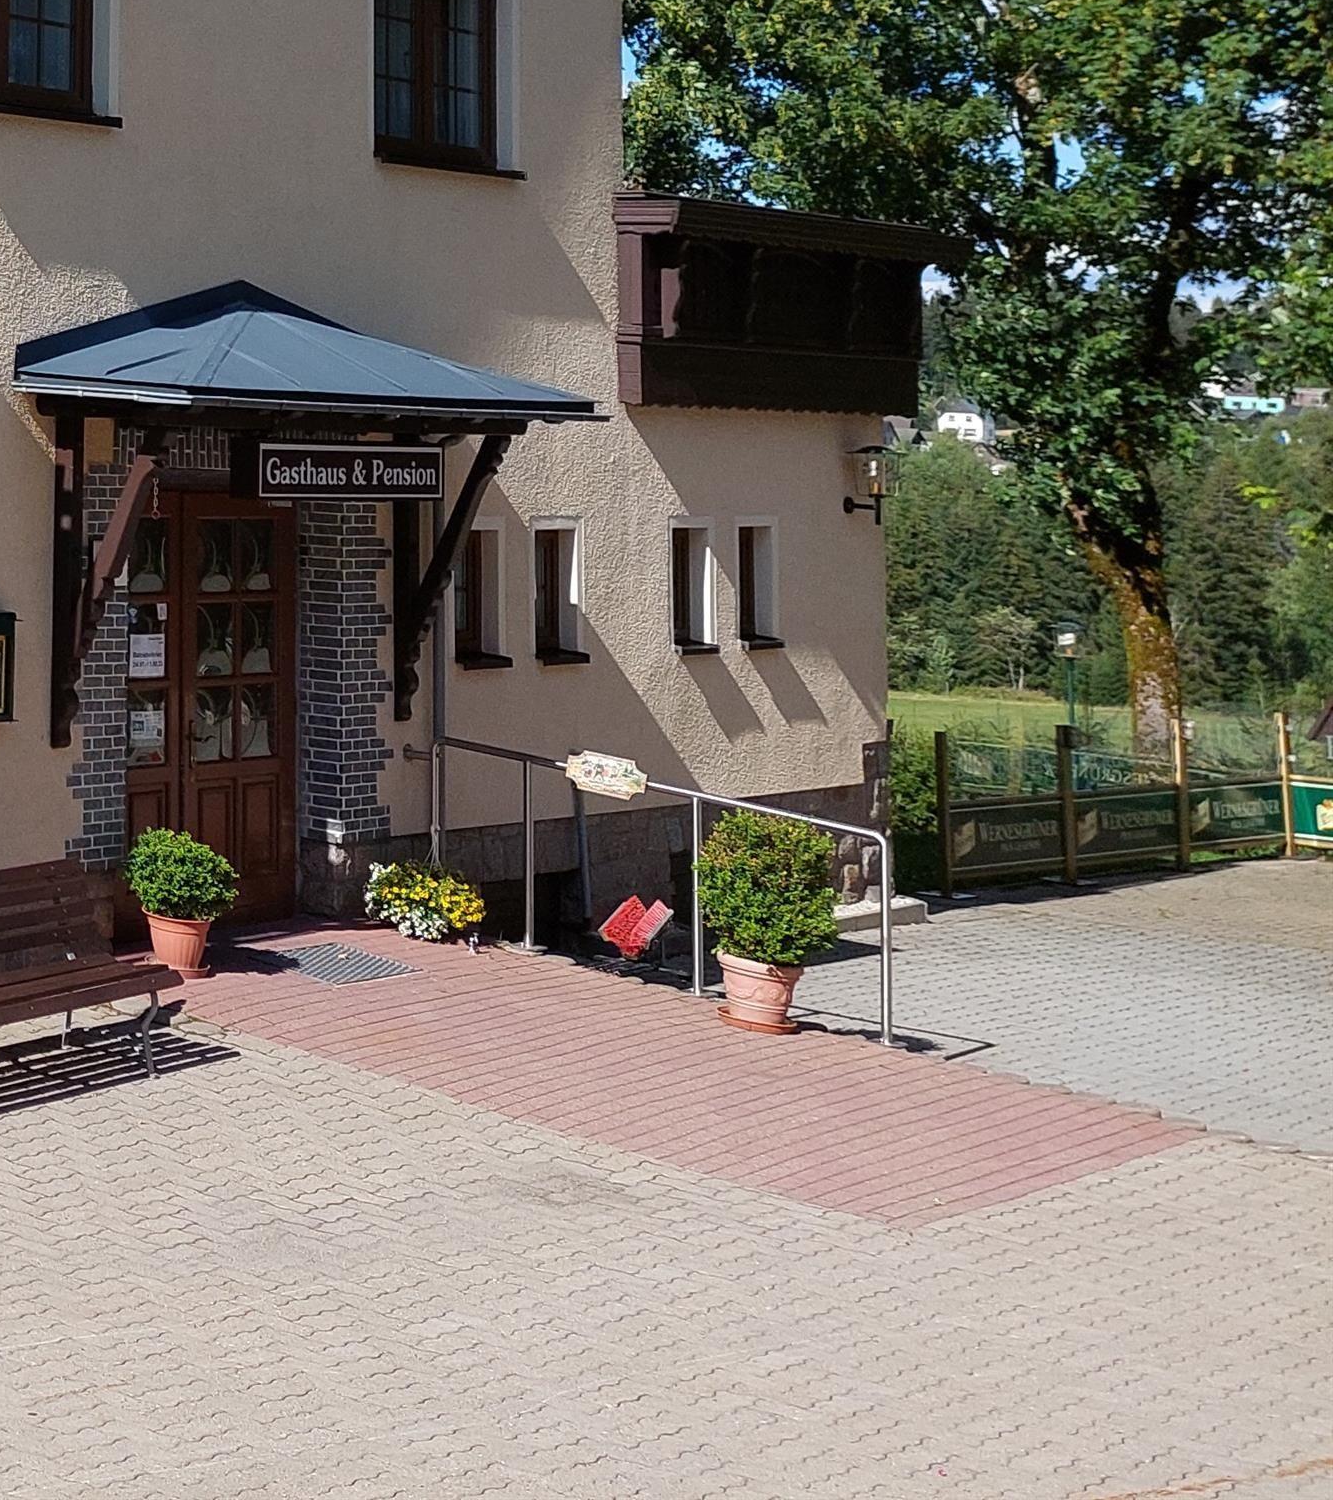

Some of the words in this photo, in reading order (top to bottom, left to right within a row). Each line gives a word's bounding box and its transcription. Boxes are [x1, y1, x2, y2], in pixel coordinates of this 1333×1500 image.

[266, 457, 347, 486] Gasthaus
[352, 458, 367, 486] &
[372, 459, 437, 487] Pension
